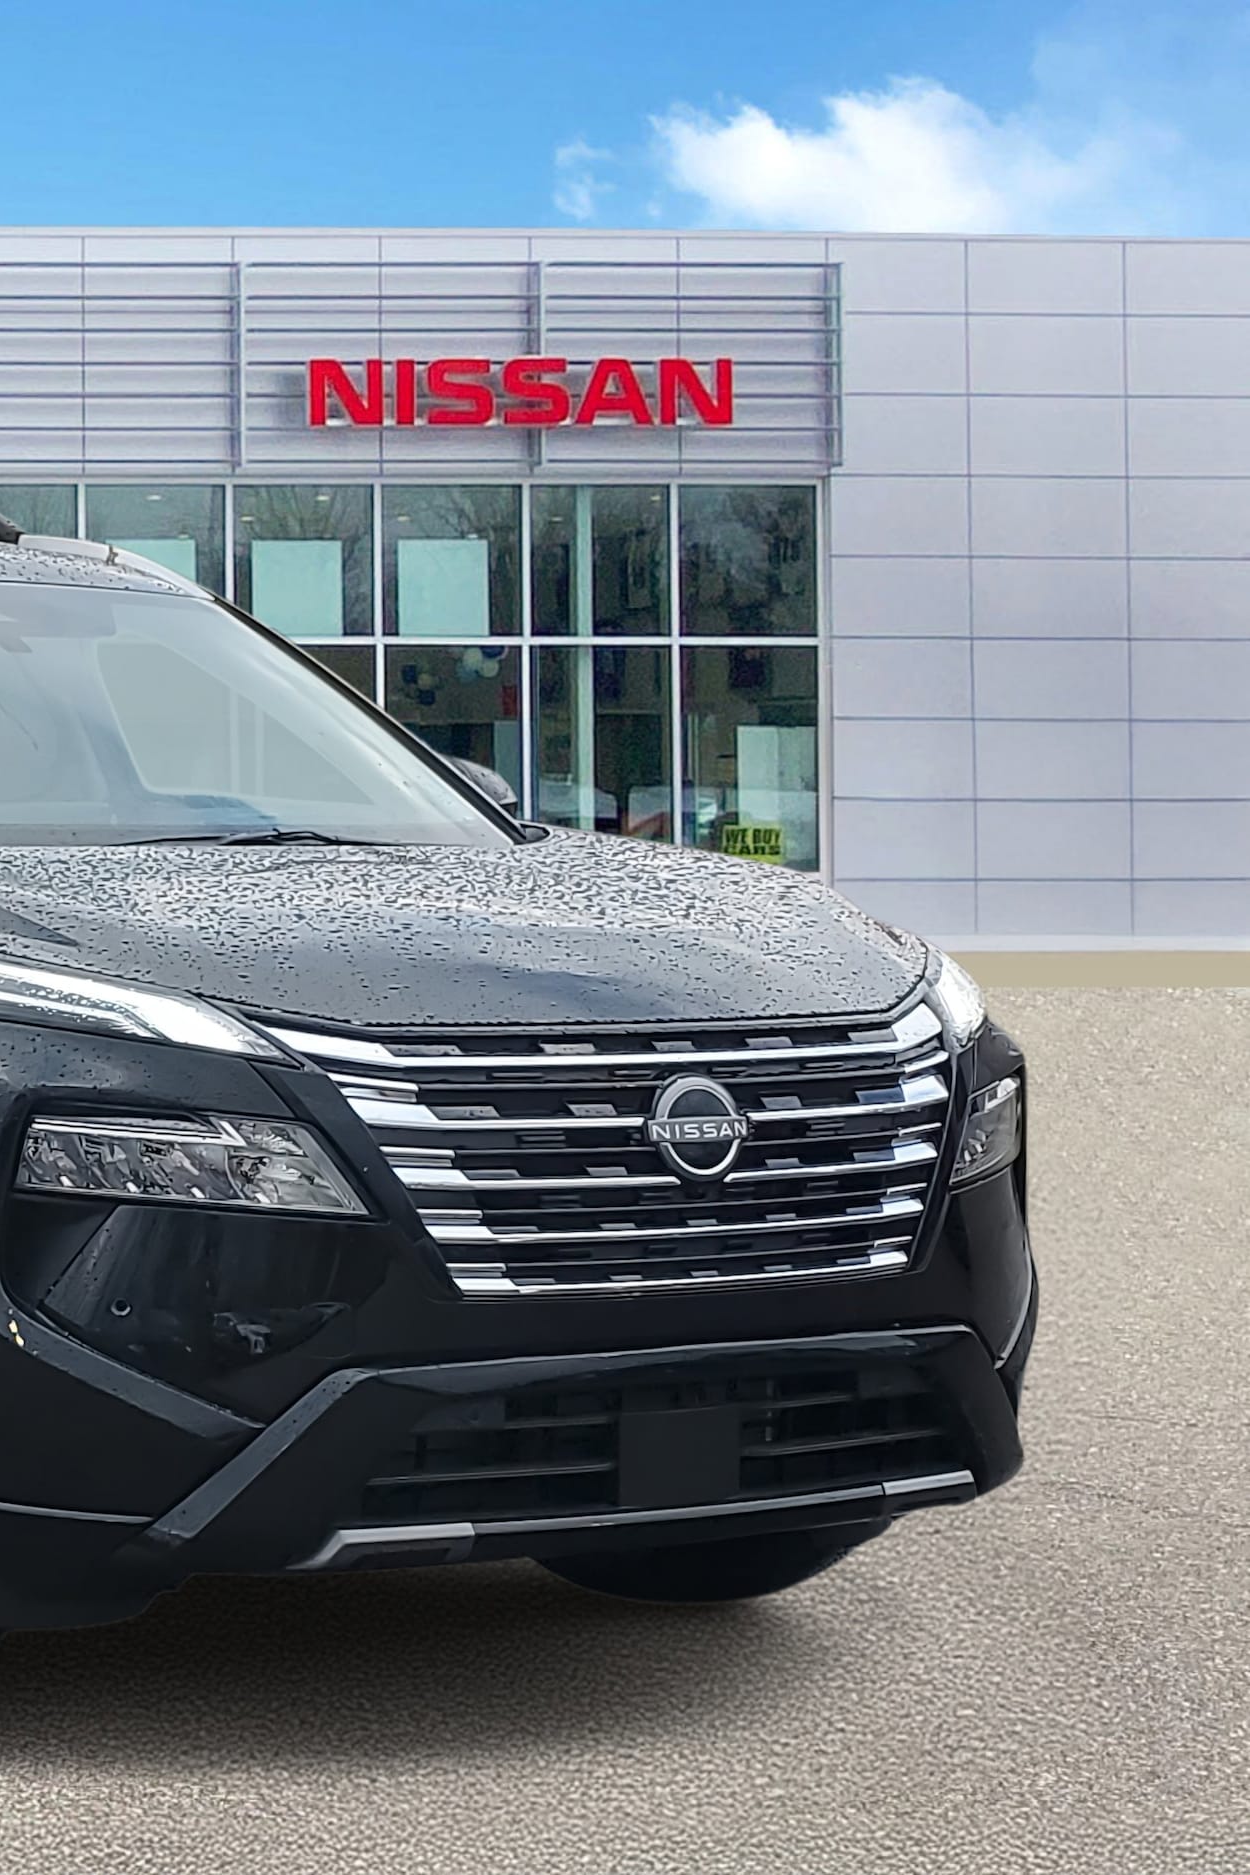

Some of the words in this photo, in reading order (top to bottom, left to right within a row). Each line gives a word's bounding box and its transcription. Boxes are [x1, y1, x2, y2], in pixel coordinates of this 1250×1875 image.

[309, 358, 734, 426] NISSAN
[724, 829, 747, 844] WE
[753, 829, 781, 844] BUY
[652, 1121, 747, 1140] NISSAN
